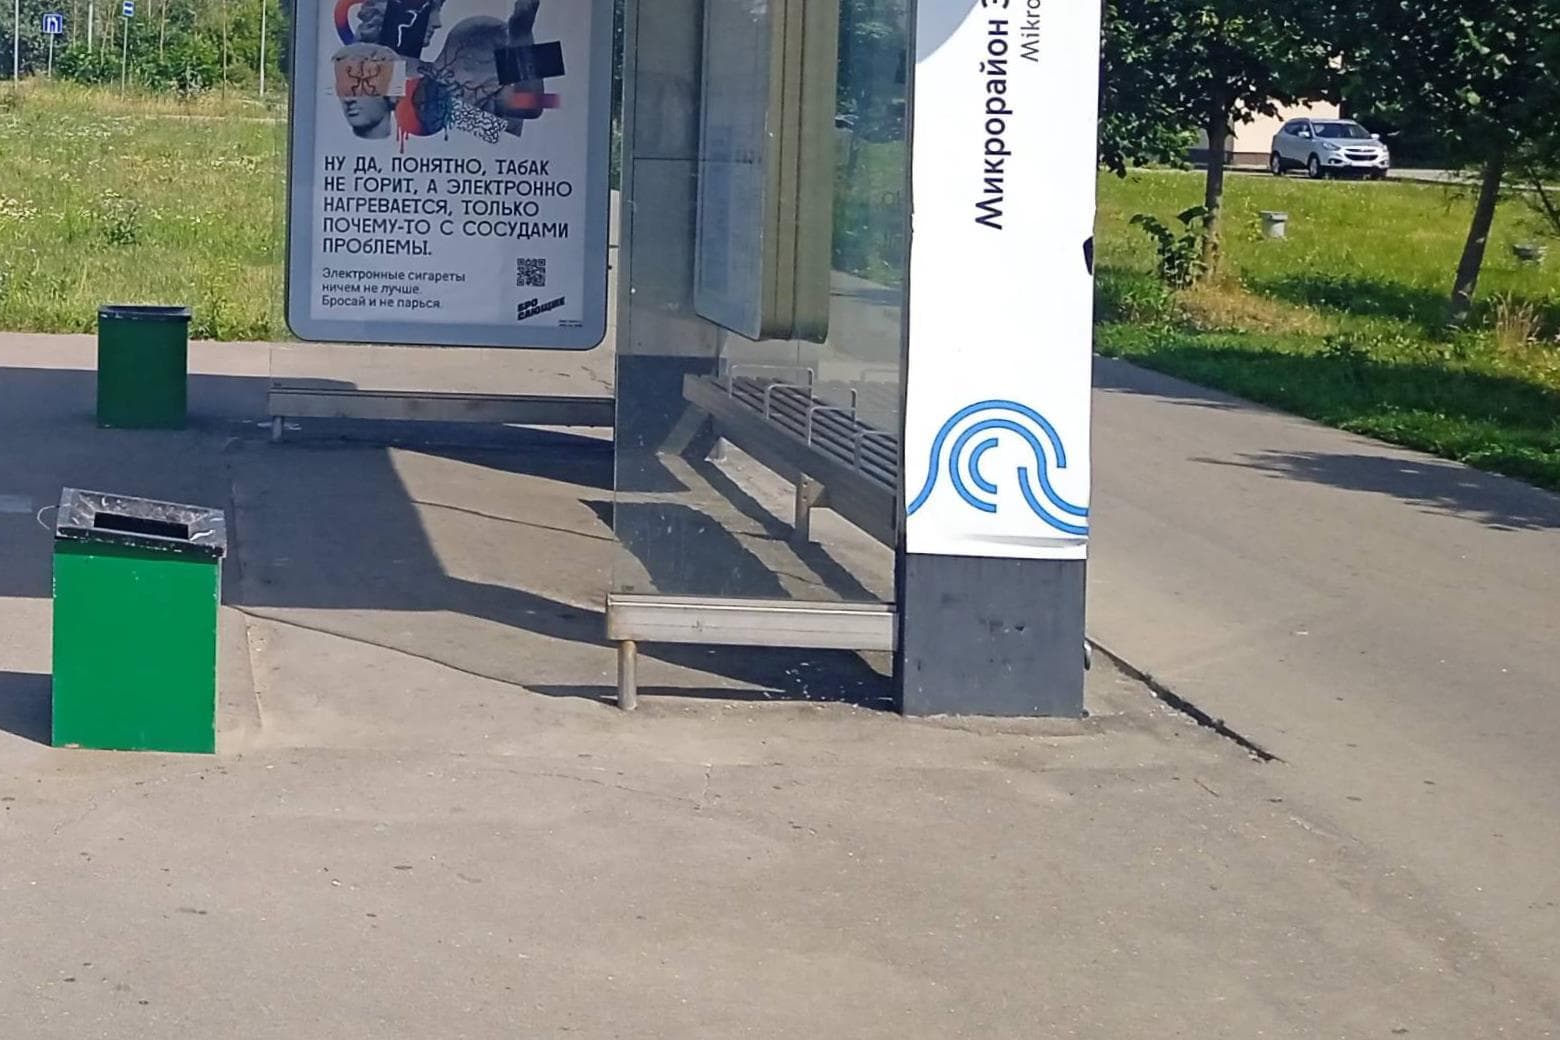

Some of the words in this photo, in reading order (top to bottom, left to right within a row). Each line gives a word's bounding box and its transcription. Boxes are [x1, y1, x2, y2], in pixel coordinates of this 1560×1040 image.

[975, 20, 1013, 230] Микрорайон
[324, 156, 346, 171] НУ
[353, 156, 382, 174] ДА,
[391, 156, 487, 176] ПОНЯТНО,
[324, 176, 345, 191] НЕ
[355, 177, 418, 195] ГОРИТ,
[426, 179, 438, 194] А
[446, 179, 573, 197] ЭЛЕКТРОННО
[323, 197, 453, 216] НАГРЕВАЕТСЯ,
[461, 199, 540, 217] ТОЛЬКО
[323, 217, 431, 235] ПОЧЕМУ-ТО
[440, 220, 454, 236] С
[462, 220, 569, 240] СОСУДАМИ
[322, 267, 405, 281] Электронные
[407, 271, 466, 283] сигареты
[322, 283, 360, 293] ничем
[363, 284, 378, 293] не
[322, 295, 366, 307] Бросай
[369, 298, 377, 306] и
[380, 299, 394, 307] не
